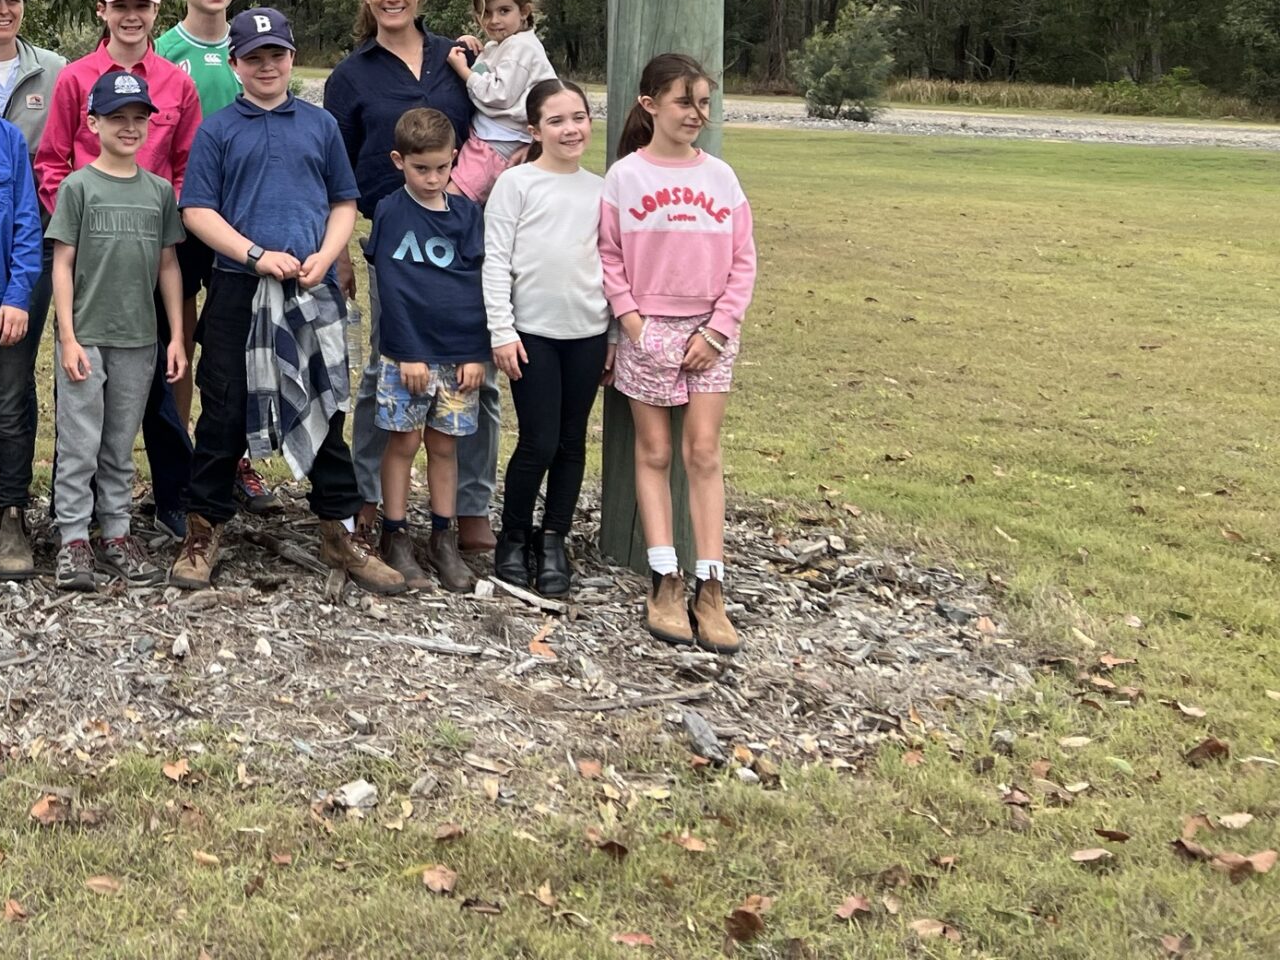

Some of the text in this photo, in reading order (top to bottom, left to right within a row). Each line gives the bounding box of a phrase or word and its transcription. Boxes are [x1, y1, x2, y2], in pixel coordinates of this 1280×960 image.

[253, 15, 271, 32] B
[628, 187, 731, 224] LONSDALE
[392, 230, 455, 268] AO
